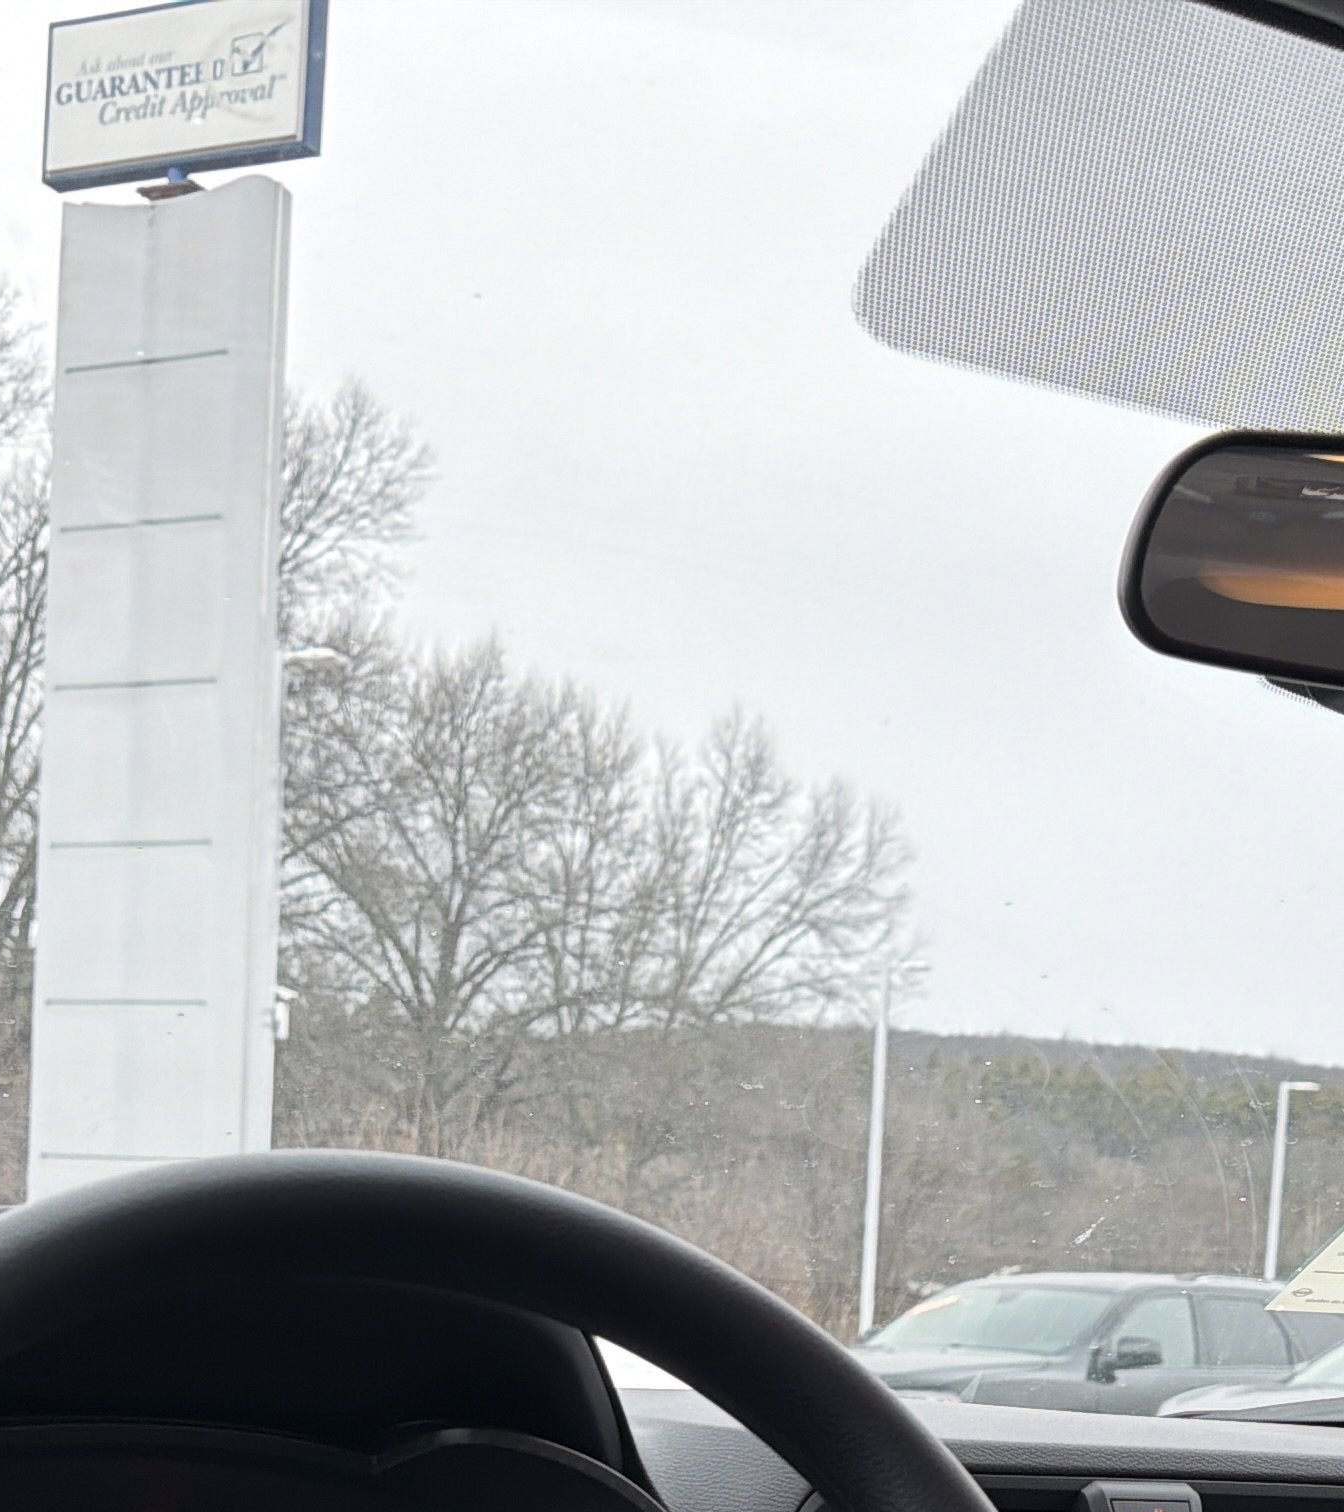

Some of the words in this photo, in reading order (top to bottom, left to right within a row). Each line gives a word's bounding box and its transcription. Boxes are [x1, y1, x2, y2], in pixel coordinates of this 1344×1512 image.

[76, 60, 101, 77] Ask
[106, 53, 144, 70] about
[147, 50, 173, 65] our
[98, 94, 166, 125] Credit
[170, 75, 276, 121] Approval
